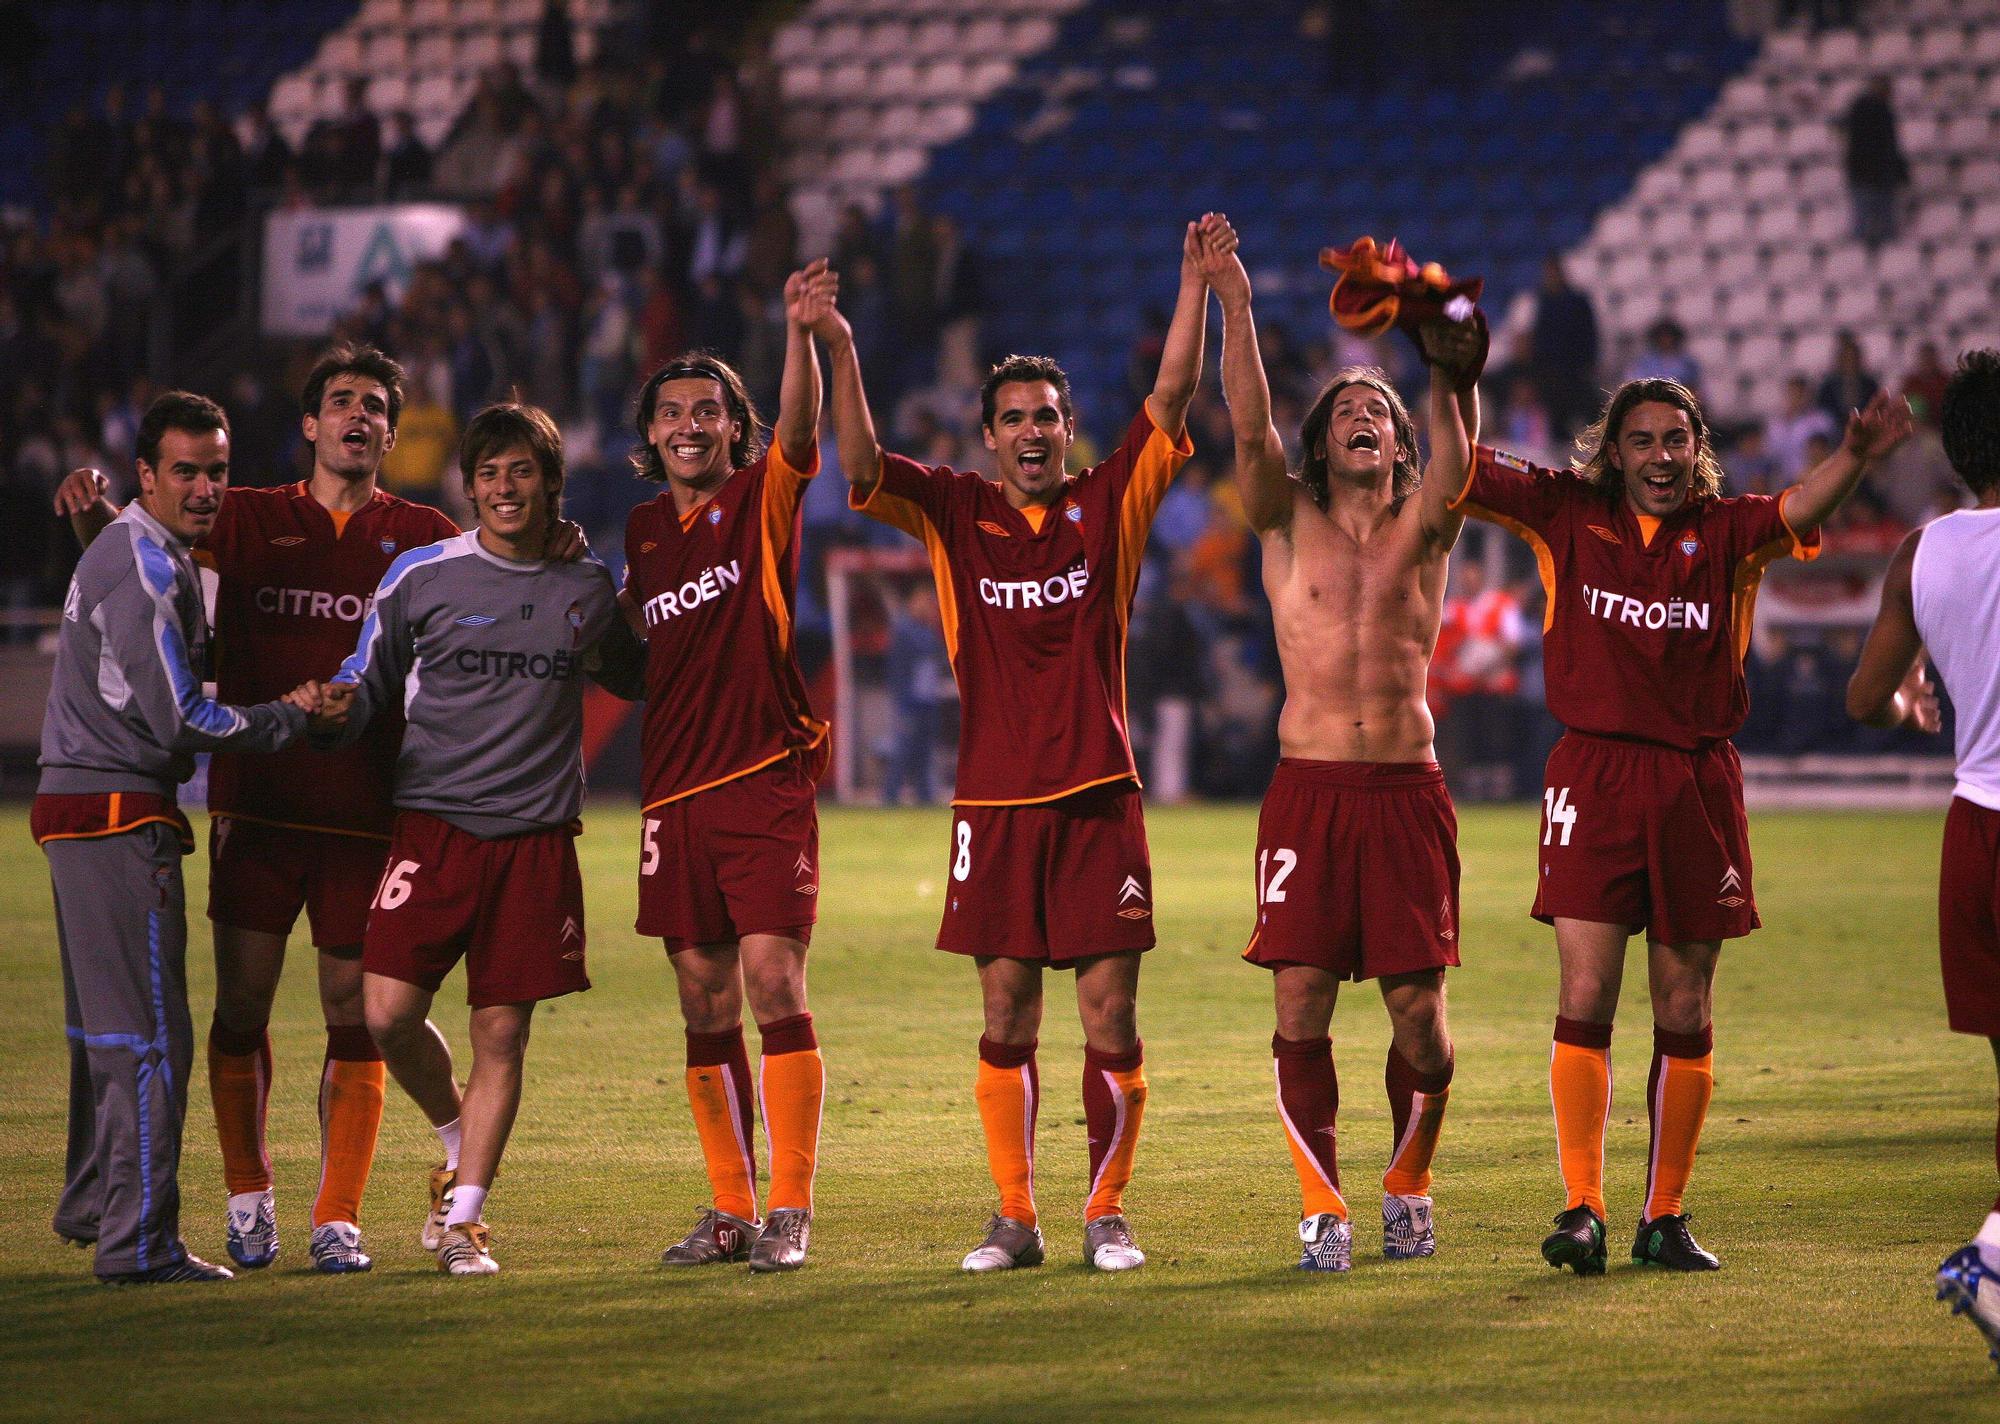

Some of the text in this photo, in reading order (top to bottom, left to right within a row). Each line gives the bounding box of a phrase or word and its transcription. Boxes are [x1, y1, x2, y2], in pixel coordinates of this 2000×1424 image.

[256, 586, 373, 621] CITRO
[521, 604, 533, 620] 17
[643, 560, 740, 628] ITROËN
[980, 559, 1089, 609] CITROË
[1543, 787, 1577, 846] 14
[953, 820, 971, 881] 8
[1259, 848, 1297, 906] 12
